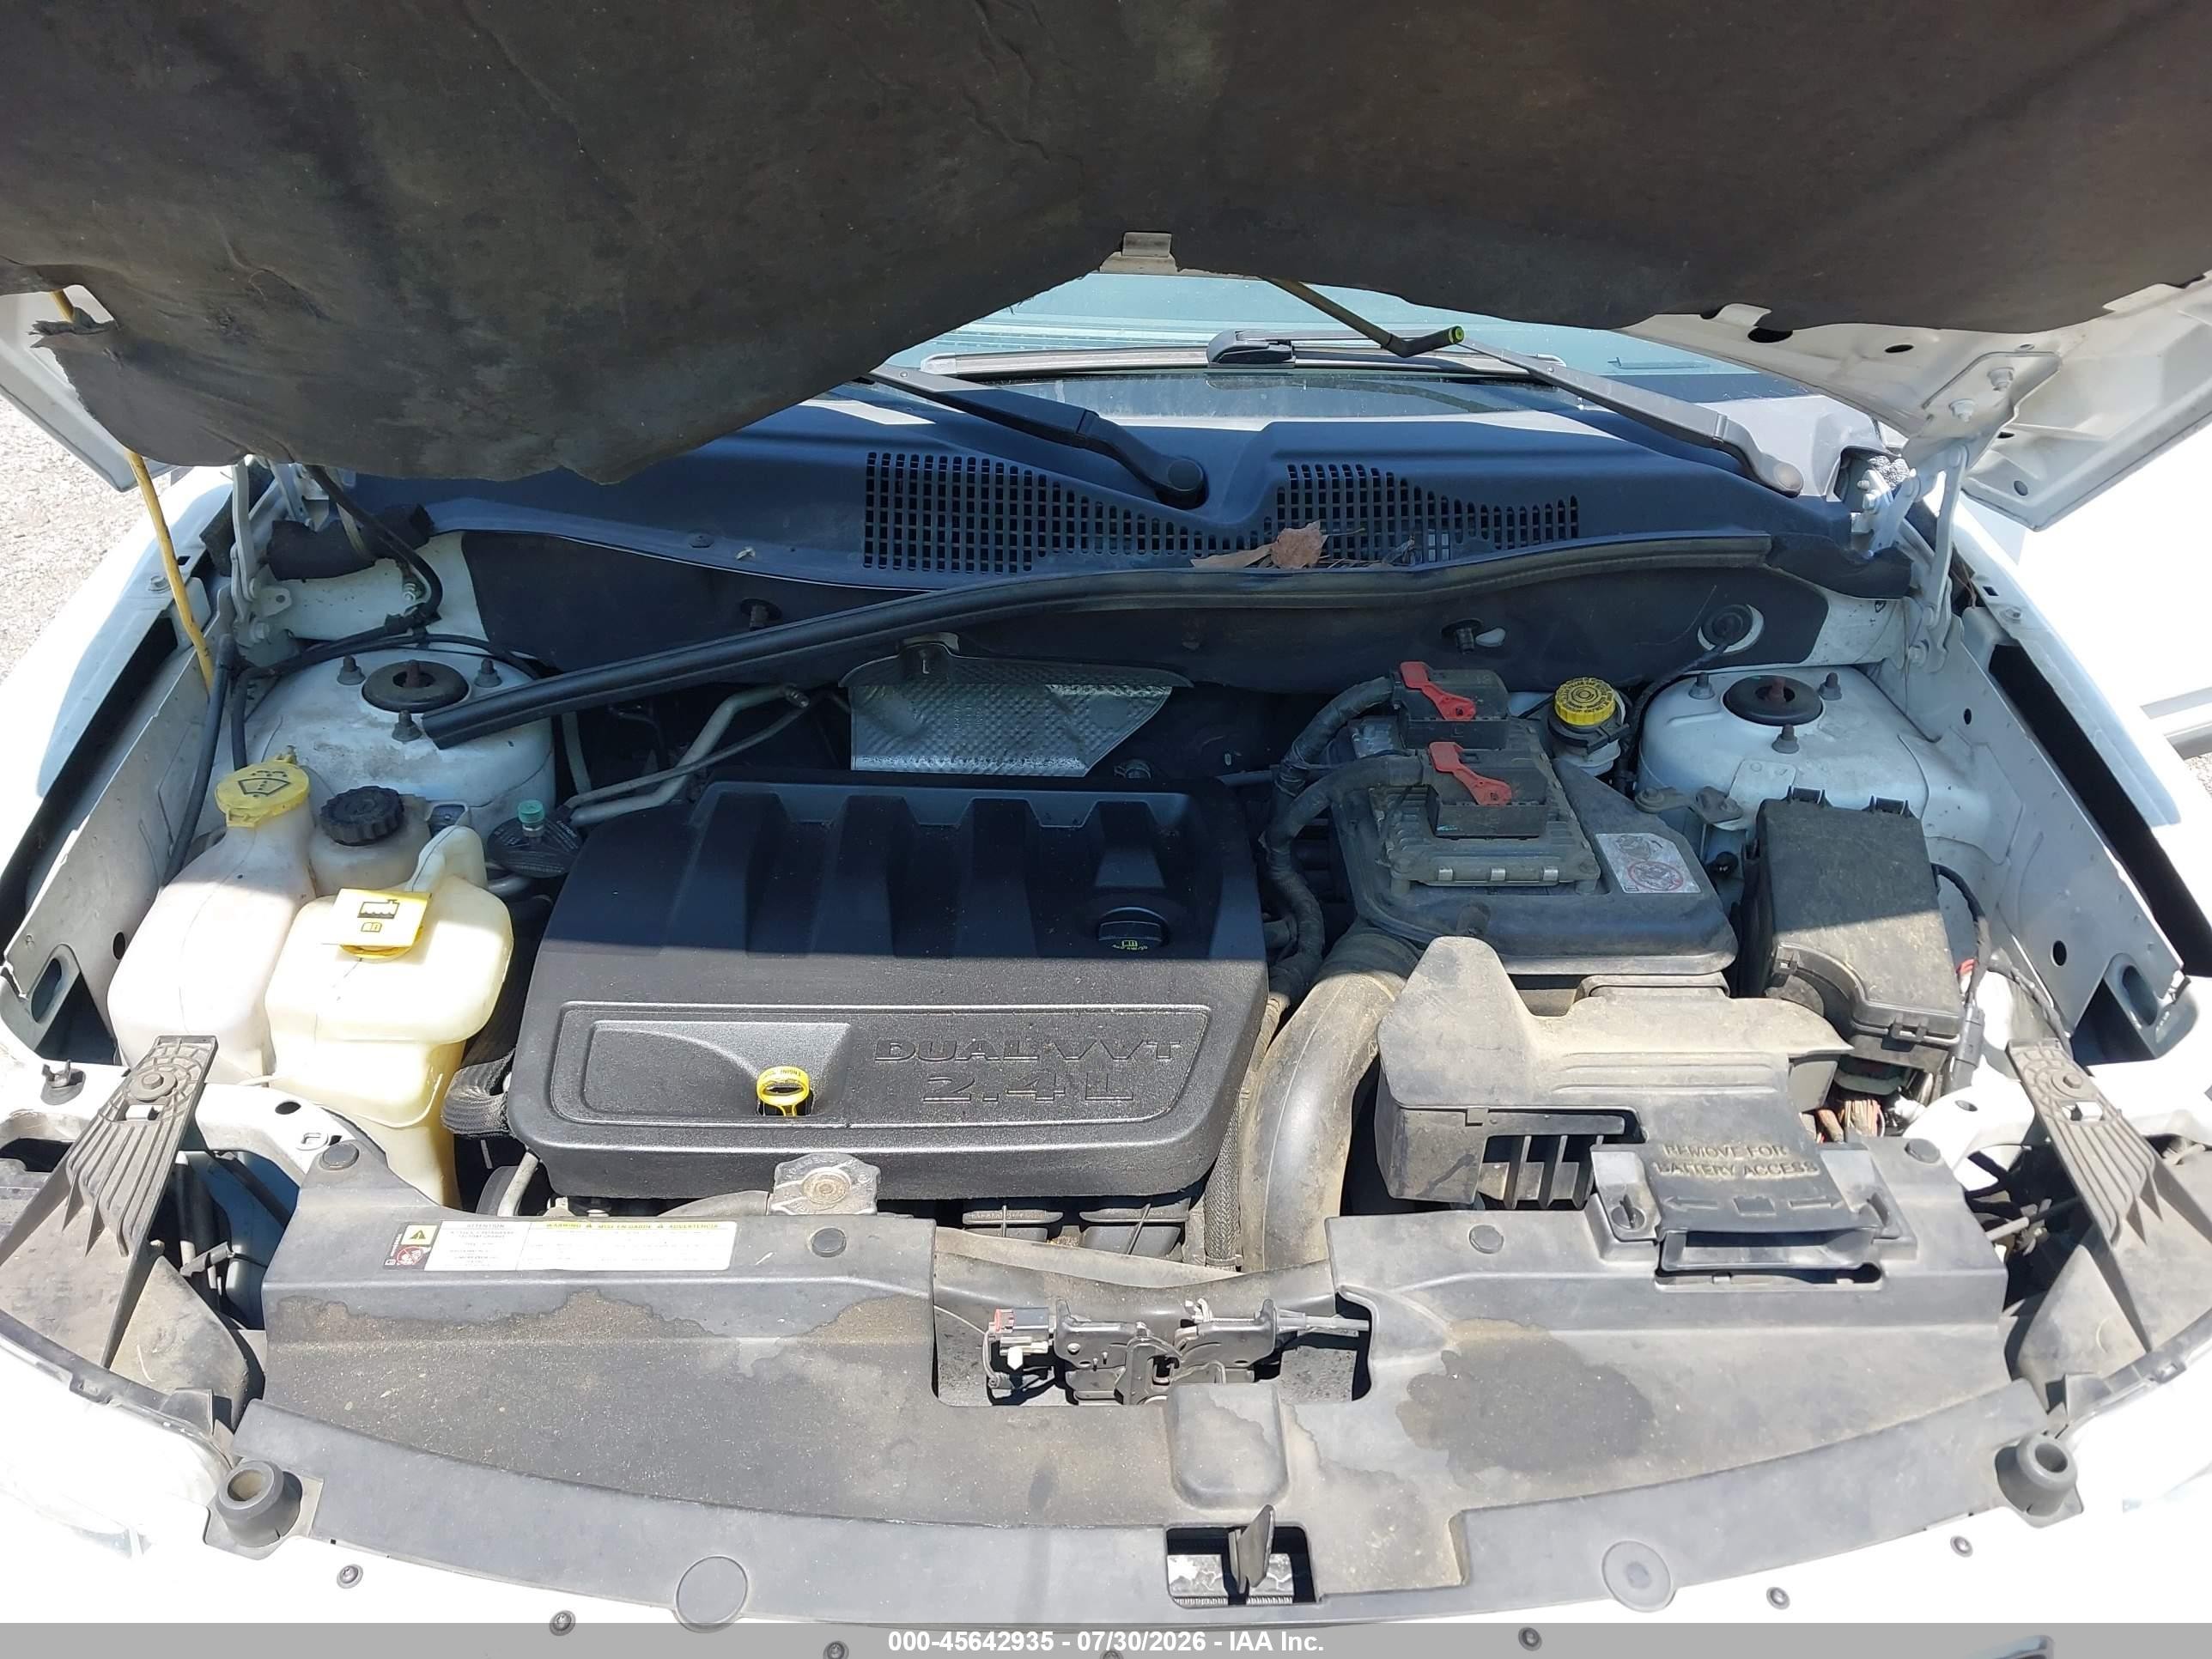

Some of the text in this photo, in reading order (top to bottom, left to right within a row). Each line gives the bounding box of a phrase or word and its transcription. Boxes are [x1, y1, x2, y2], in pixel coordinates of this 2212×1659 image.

[874, 1037, 1182, 1063] DUAL VVT
[922, 1072, 1135, 1103] 2.4L
[1663, 1145, 1787, 1159] REMOVE FOR
[1656, 1161, 1819, 1176] BATTERY ACCESS
